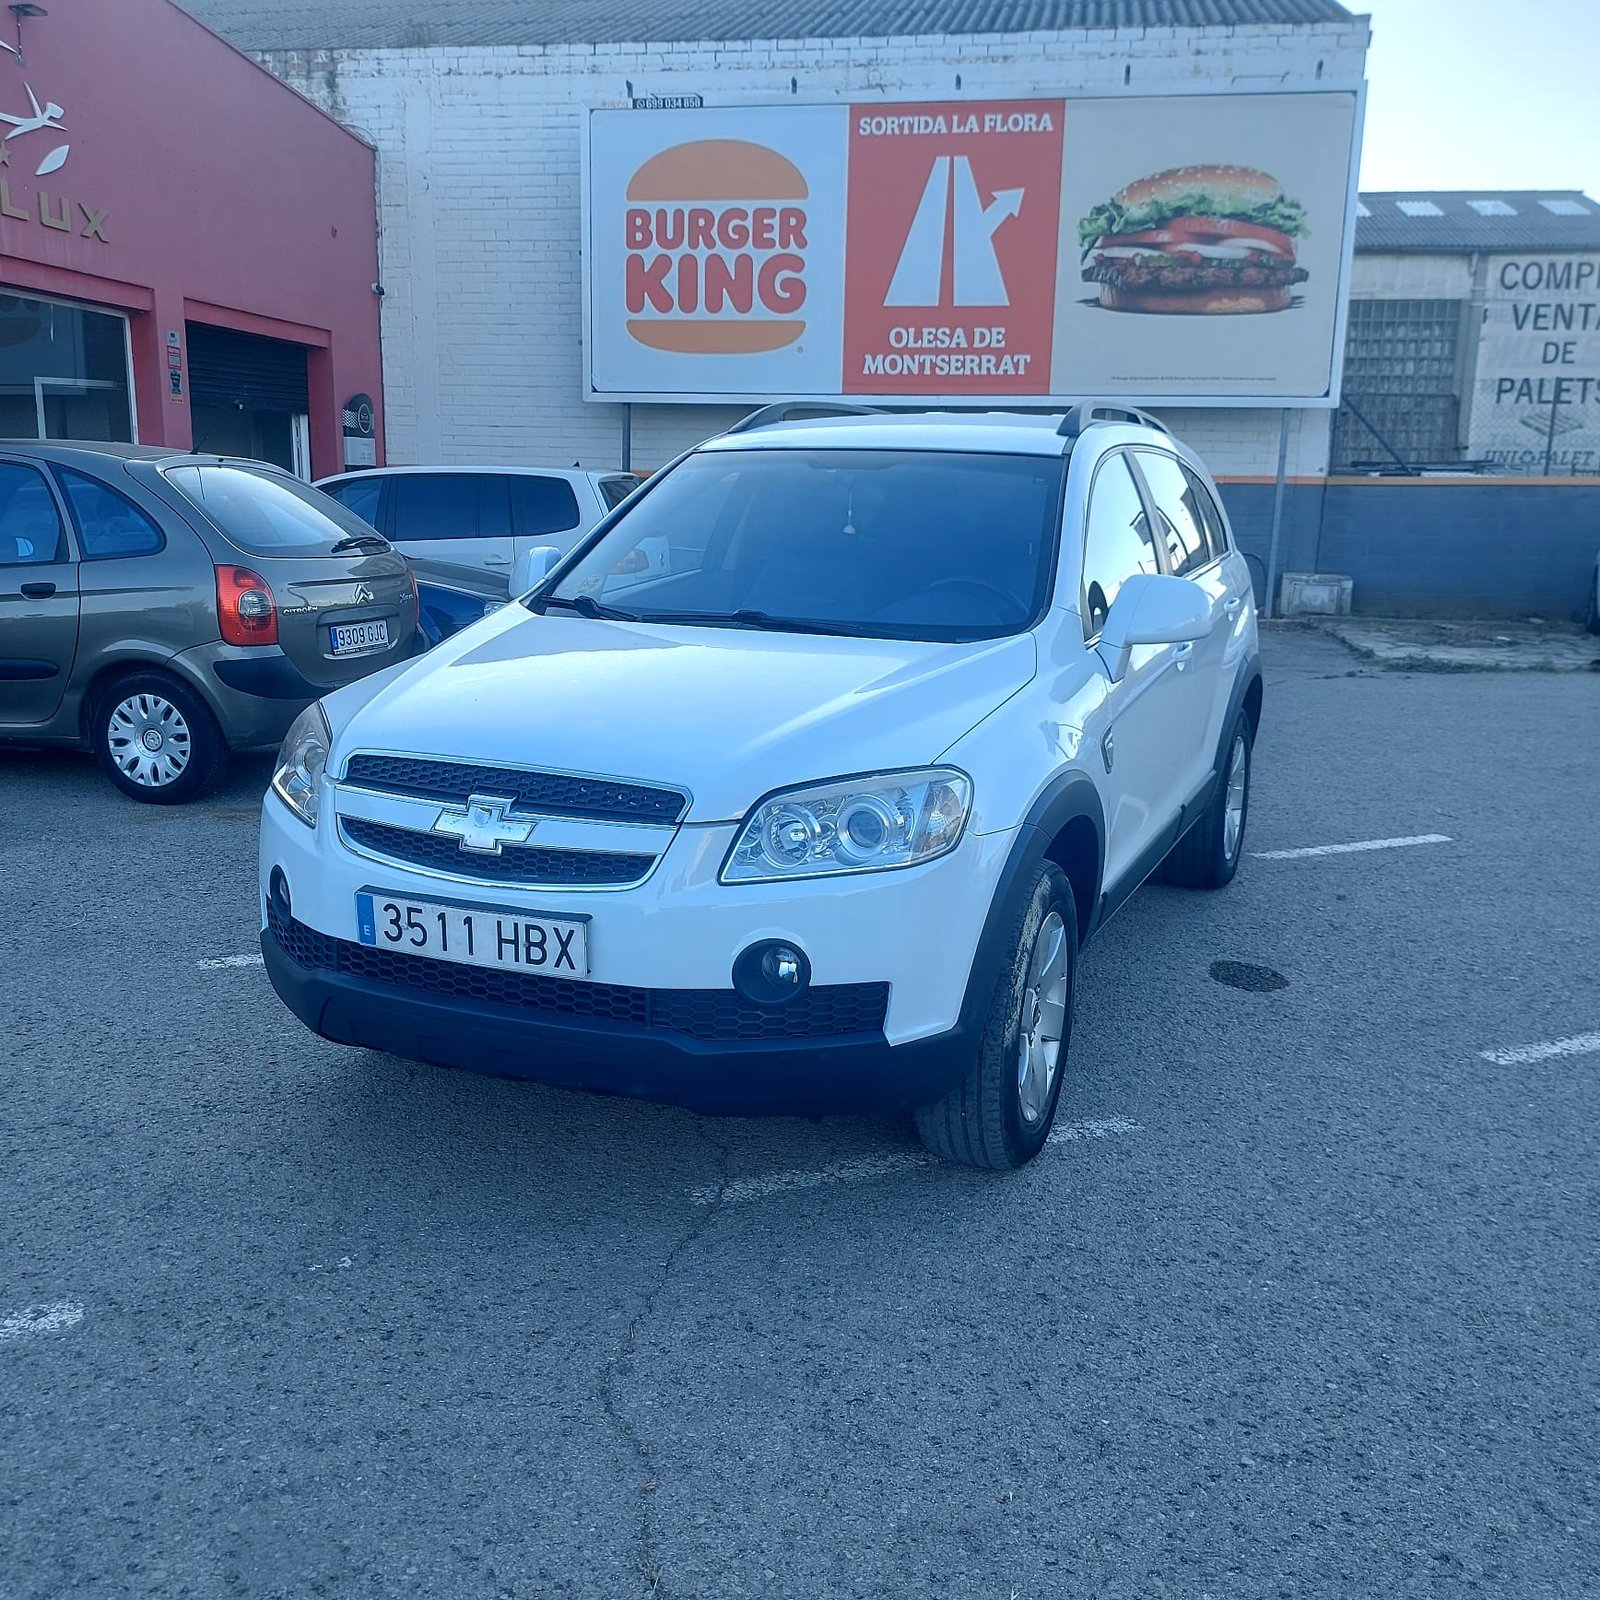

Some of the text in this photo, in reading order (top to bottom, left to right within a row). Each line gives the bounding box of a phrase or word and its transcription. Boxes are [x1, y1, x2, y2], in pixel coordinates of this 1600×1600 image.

[646, 99, 663, 109] 699
[665, 98, 682, 108] 034
[859, 112, 1053, 136] SORTIDA LA FLORA
[626, 207, 808, 250] BURGER
[626, 253, 807, 314] KING
[1499, 261, 1600, 291] COMP
[888, 326, 1006, 349] OLESA DE
[1542, 341, 1577, 364] DE
[862, 354, 1031, 376] MONTSERRAT
[338, 623, 386, 647] 9309 GJC
[363, 924, 371, 936] E
[382, 903, 576, 971] 3511 HBX
